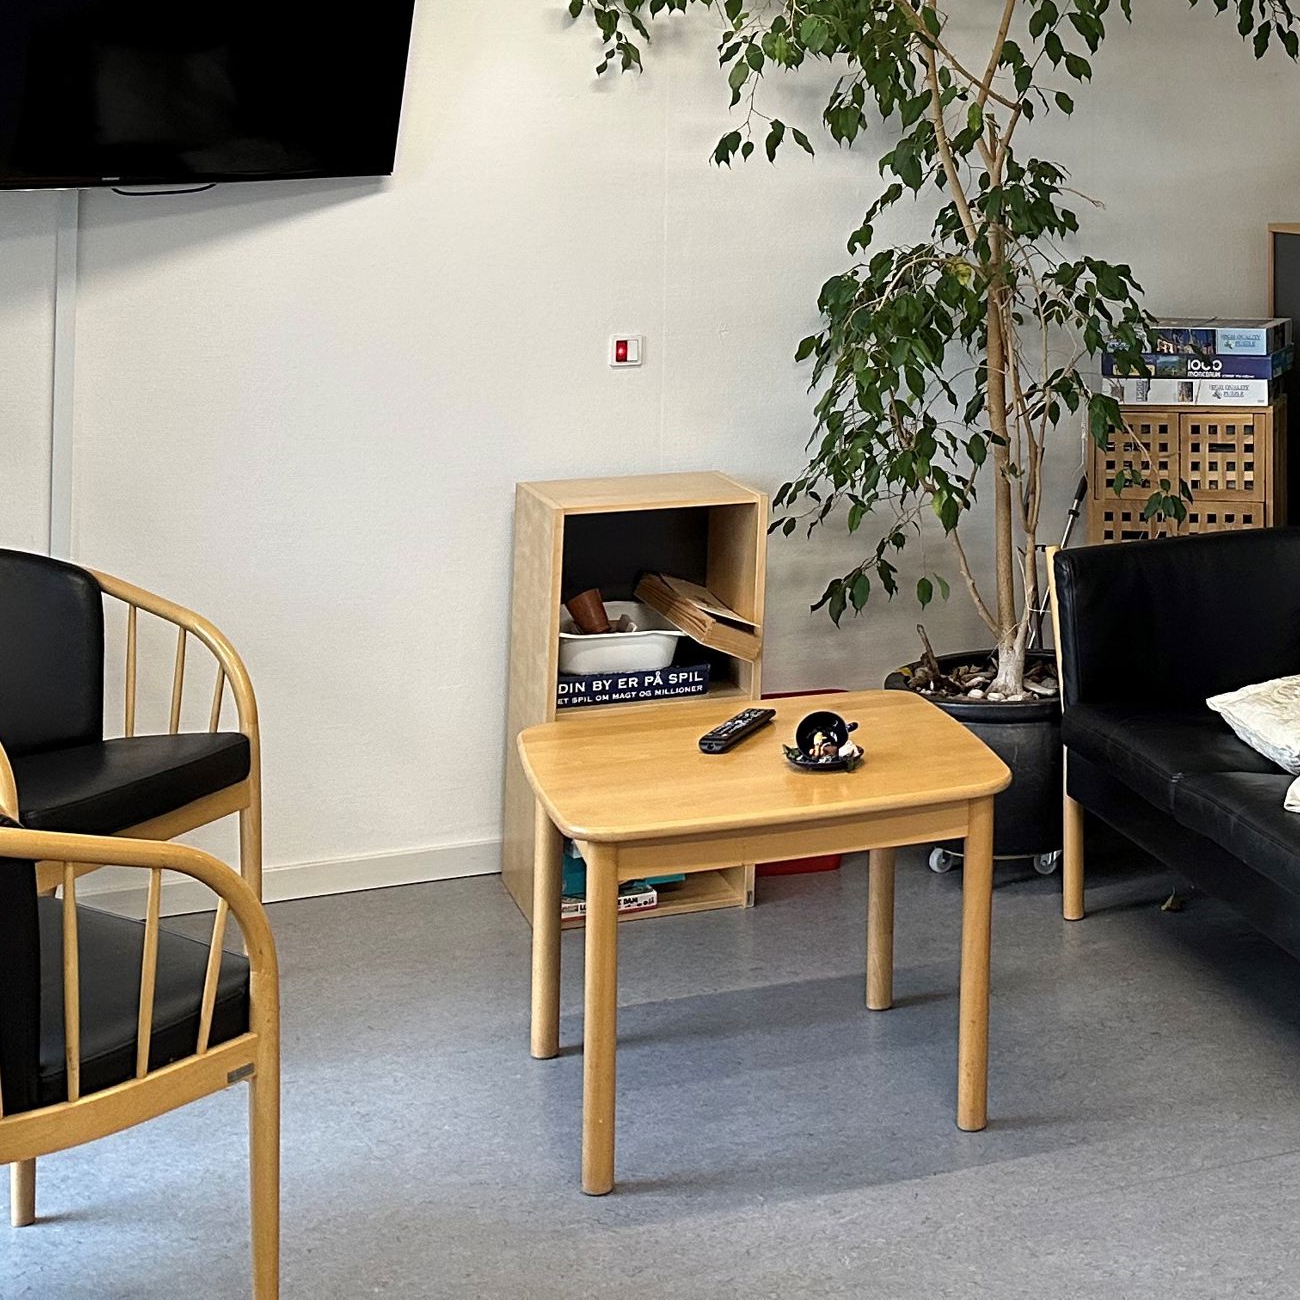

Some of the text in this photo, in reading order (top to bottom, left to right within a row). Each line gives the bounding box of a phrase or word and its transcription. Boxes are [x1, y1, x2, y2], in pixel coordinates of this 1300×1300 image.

[558, 671, 704, 694] DIN BY ER PÅ SPIL
[572, 696, 593, 704] SPIL
[612, 691, 637, 700] MAGT
[654, 685, 703, 696] MILLIONER
